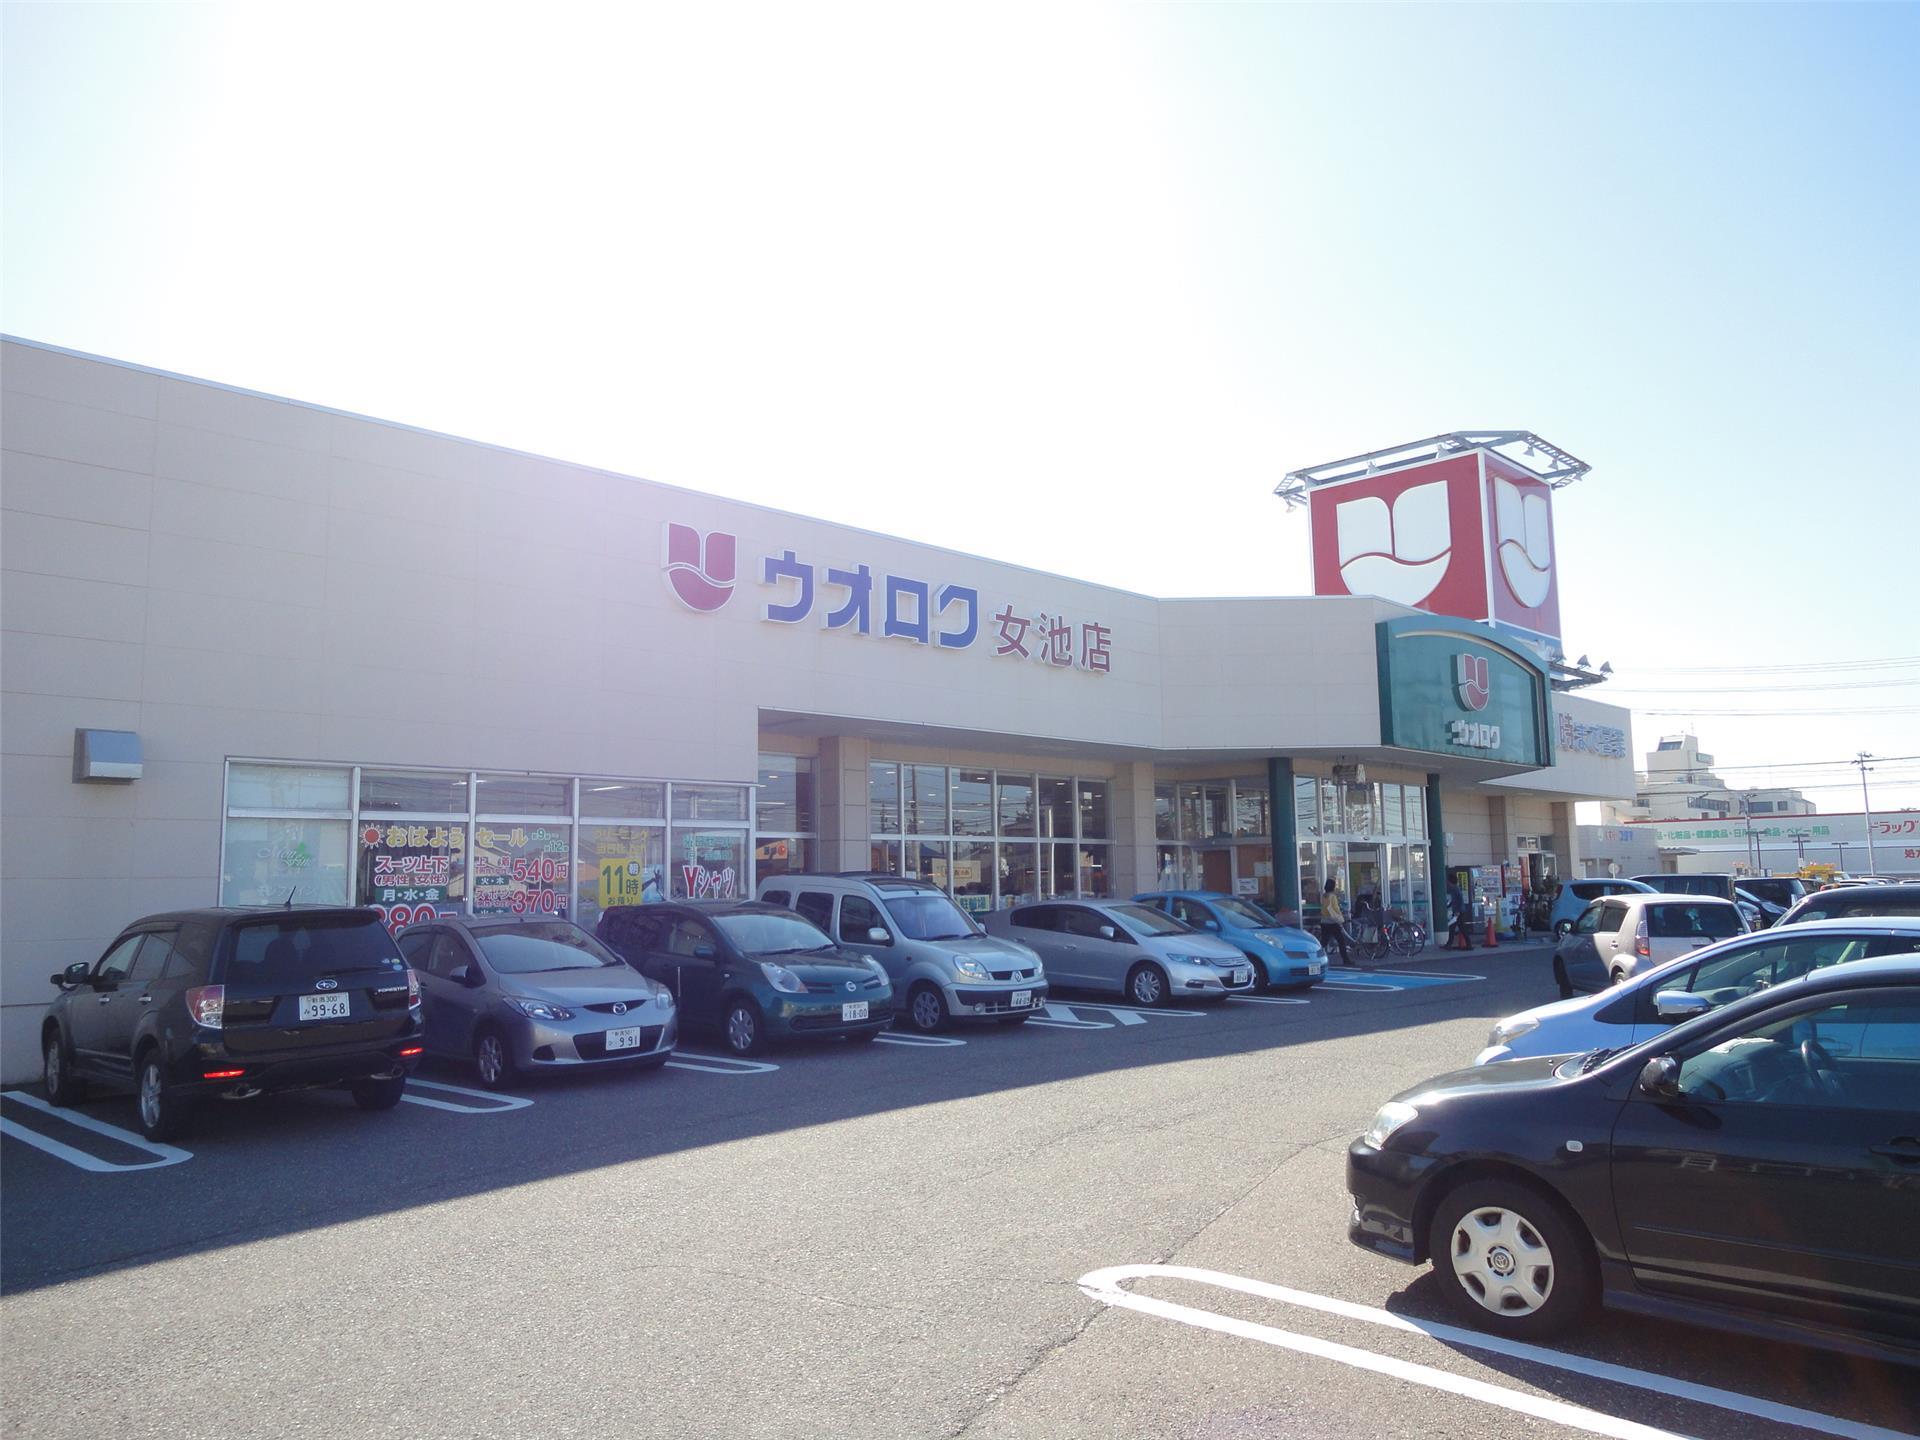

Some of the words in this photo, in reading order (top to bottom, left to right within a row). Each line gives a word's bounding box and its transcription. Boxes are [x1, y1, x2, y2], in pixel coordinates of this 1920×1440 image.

[760, 549, 979, 650] ウオロク
[992, 604, 1112, 673] 女池店
[1451, 719, 1500, 749] ウオロク
[386, 825, 465, 850] おはよう
[475, 827, 529, 849] セール
[375, 855, 449, 873] スーツ上下
[1903, 848, 1920, 859] 処
[512, 857, 569, 882] 540円
[683, 865, 735, 899] Yシャツ
[383, 888, 440, 901] 月・水・金
[511, 889, 569, 913] 370円
[311, 1003, 346, 1017] 99-68
